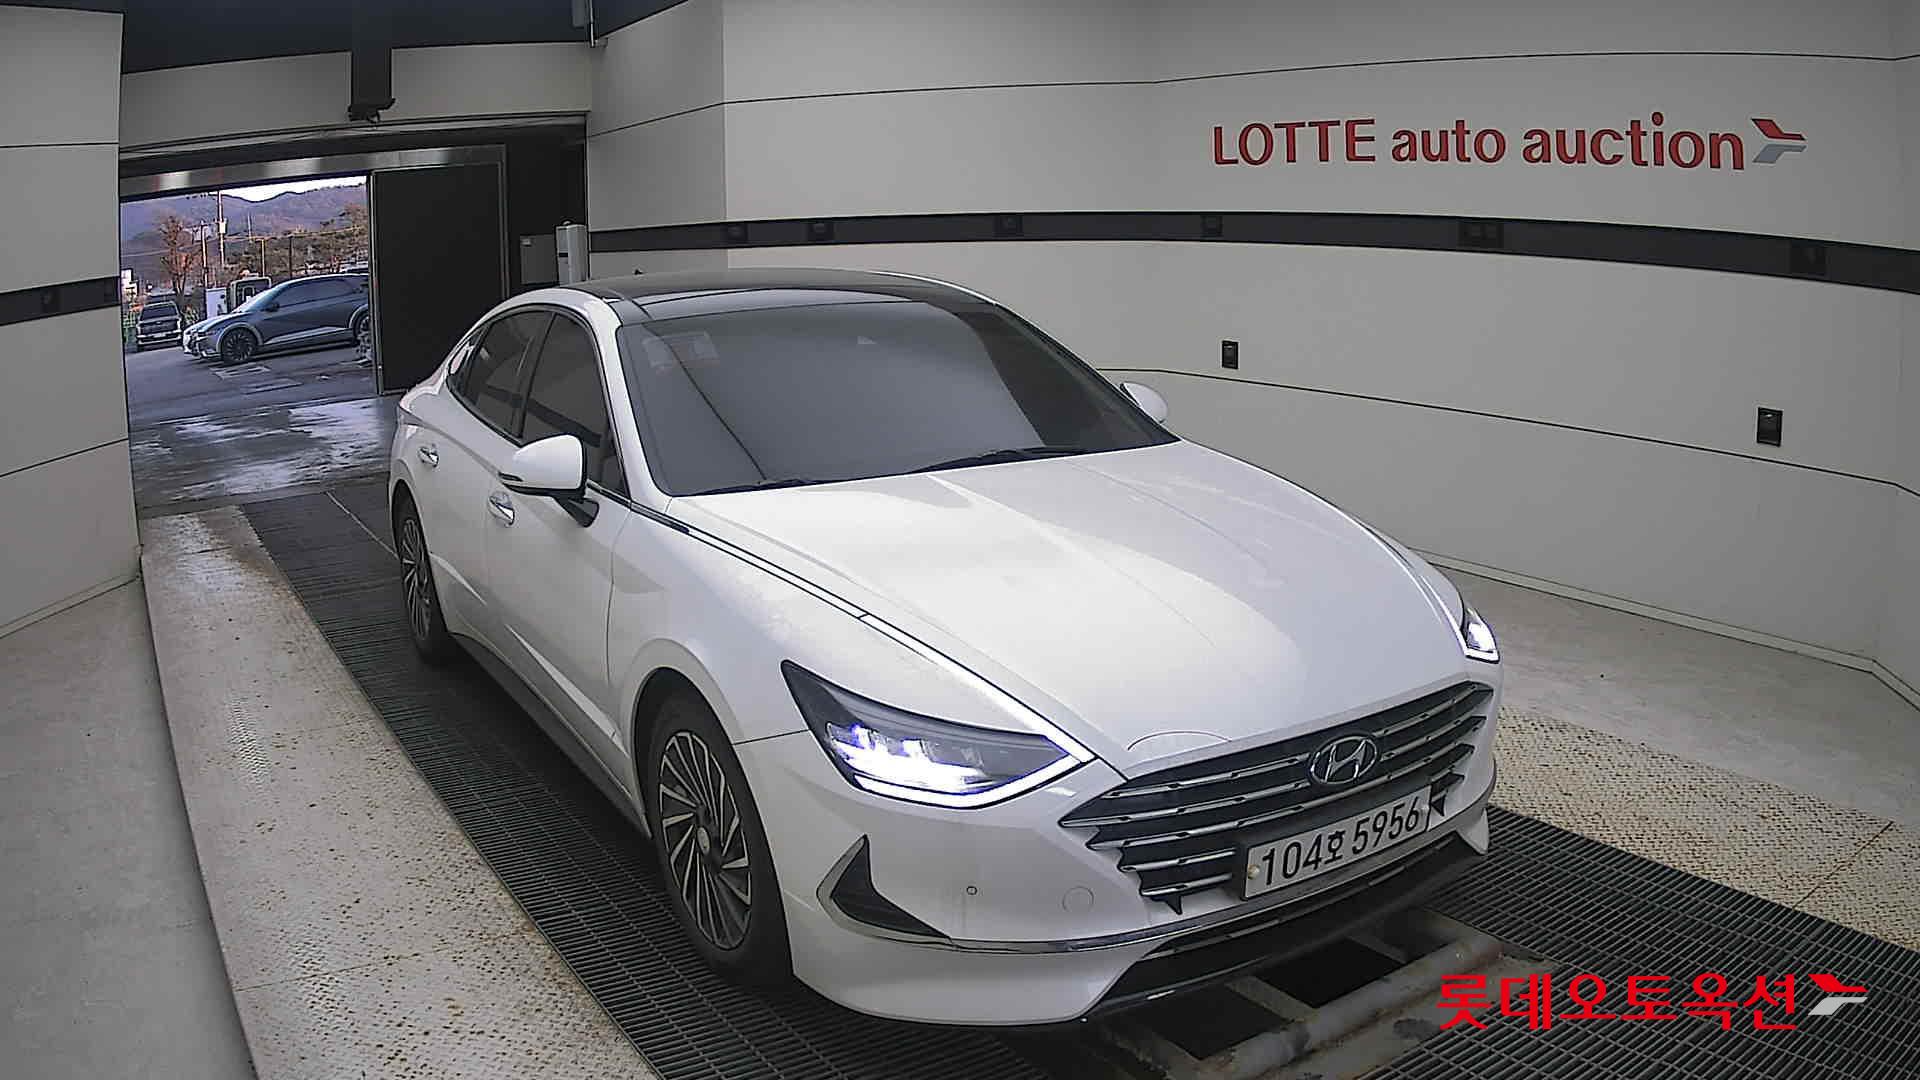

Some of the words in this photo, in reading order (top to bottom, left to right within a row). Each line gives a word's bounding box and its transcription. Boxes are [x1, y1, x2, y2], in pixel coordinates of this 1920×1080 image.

[1213, 118, 1377, 166] LOTTE
[1391, 119, 1507, 163] auto
[1522, 112, 1745, 170] auction
